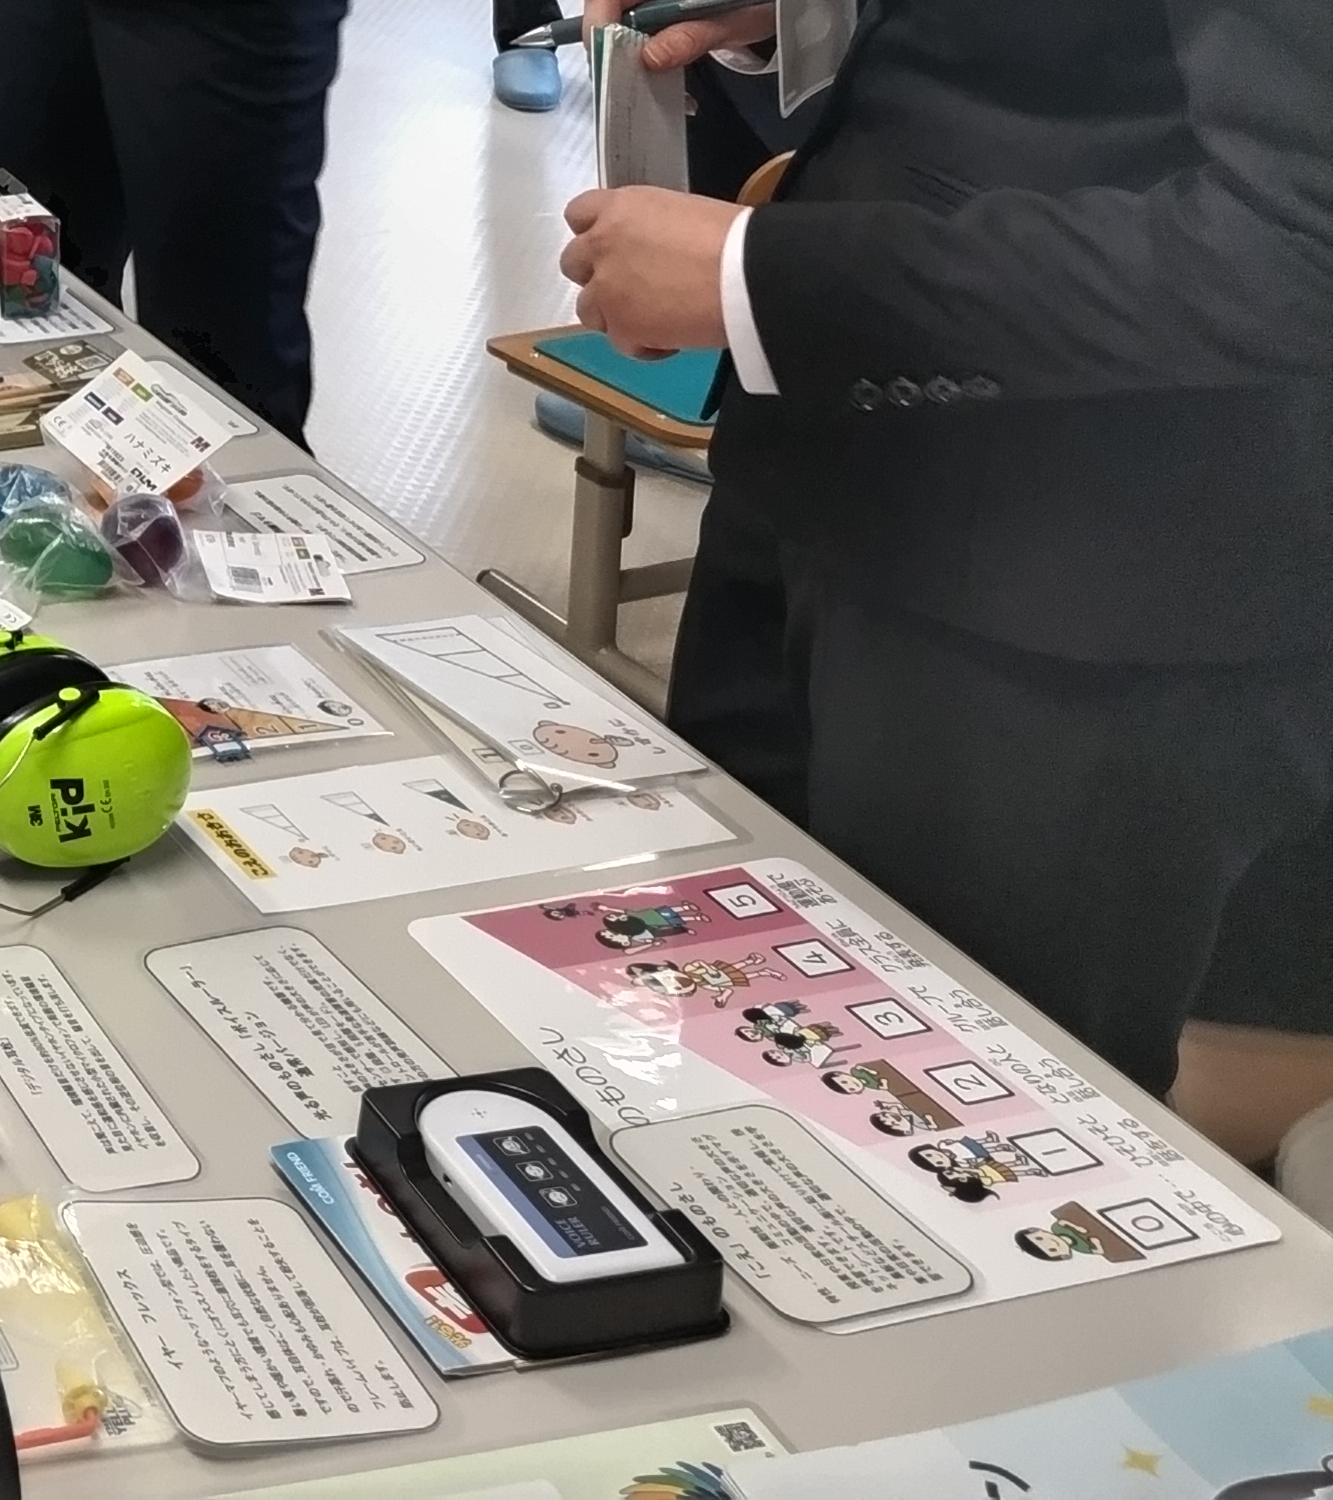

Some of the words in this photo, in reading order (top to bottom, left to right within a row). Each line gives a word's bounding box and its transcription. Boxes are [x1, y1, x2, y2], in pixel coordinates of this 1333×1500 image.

[123, 431, 172, 475] ハナミズキ
[256, 724, 279, 735] 2
[27, 804, 44, 827] 3M
[50, 778, 95, 842] kid
[196, 811, 269, 877] こえのおおきさ
[732, 891, 757, 910] 5
[799, 877, 838, 906] あそぶ
[800, 950, 829, 967] 4
[829, 918, 899, 974] クラス全員に
[878, 930, 932, 970] 発表する
[875, 1009, 907, 1028] 3
[908, 984, 975, 1034] グループで
[953, 988, 1010, 1032] 話し合う
[178, 965, 333, 1122] 光る声のものさし「ボイスルーラー」
[243, 1010, 315, 1079] 通常バージョン
[955, 1073, 988, 1092] 2
[985, 1043, 1072, 1105] となりの人と
[1041, 1056, 1102, 1101] 話し合う
[1040, 1147, 1069, 1156] 1
[1075, 1113, 1156, 1170] ひそひそと
[1118, 1117, 1184, 1164] 話をする
[286, 1151, 317, 1179] FRIEND
[306, 1174, 336, 1205] COM
[555, 1217, 585, 1250] VOICE
[567, 1216, 602, 1247] RULER
[1130, 1215, 1165, 1233] 0
[115, 1268, 158, 1324] フレックス
[157, 1333, 185, 1370] イヤー
